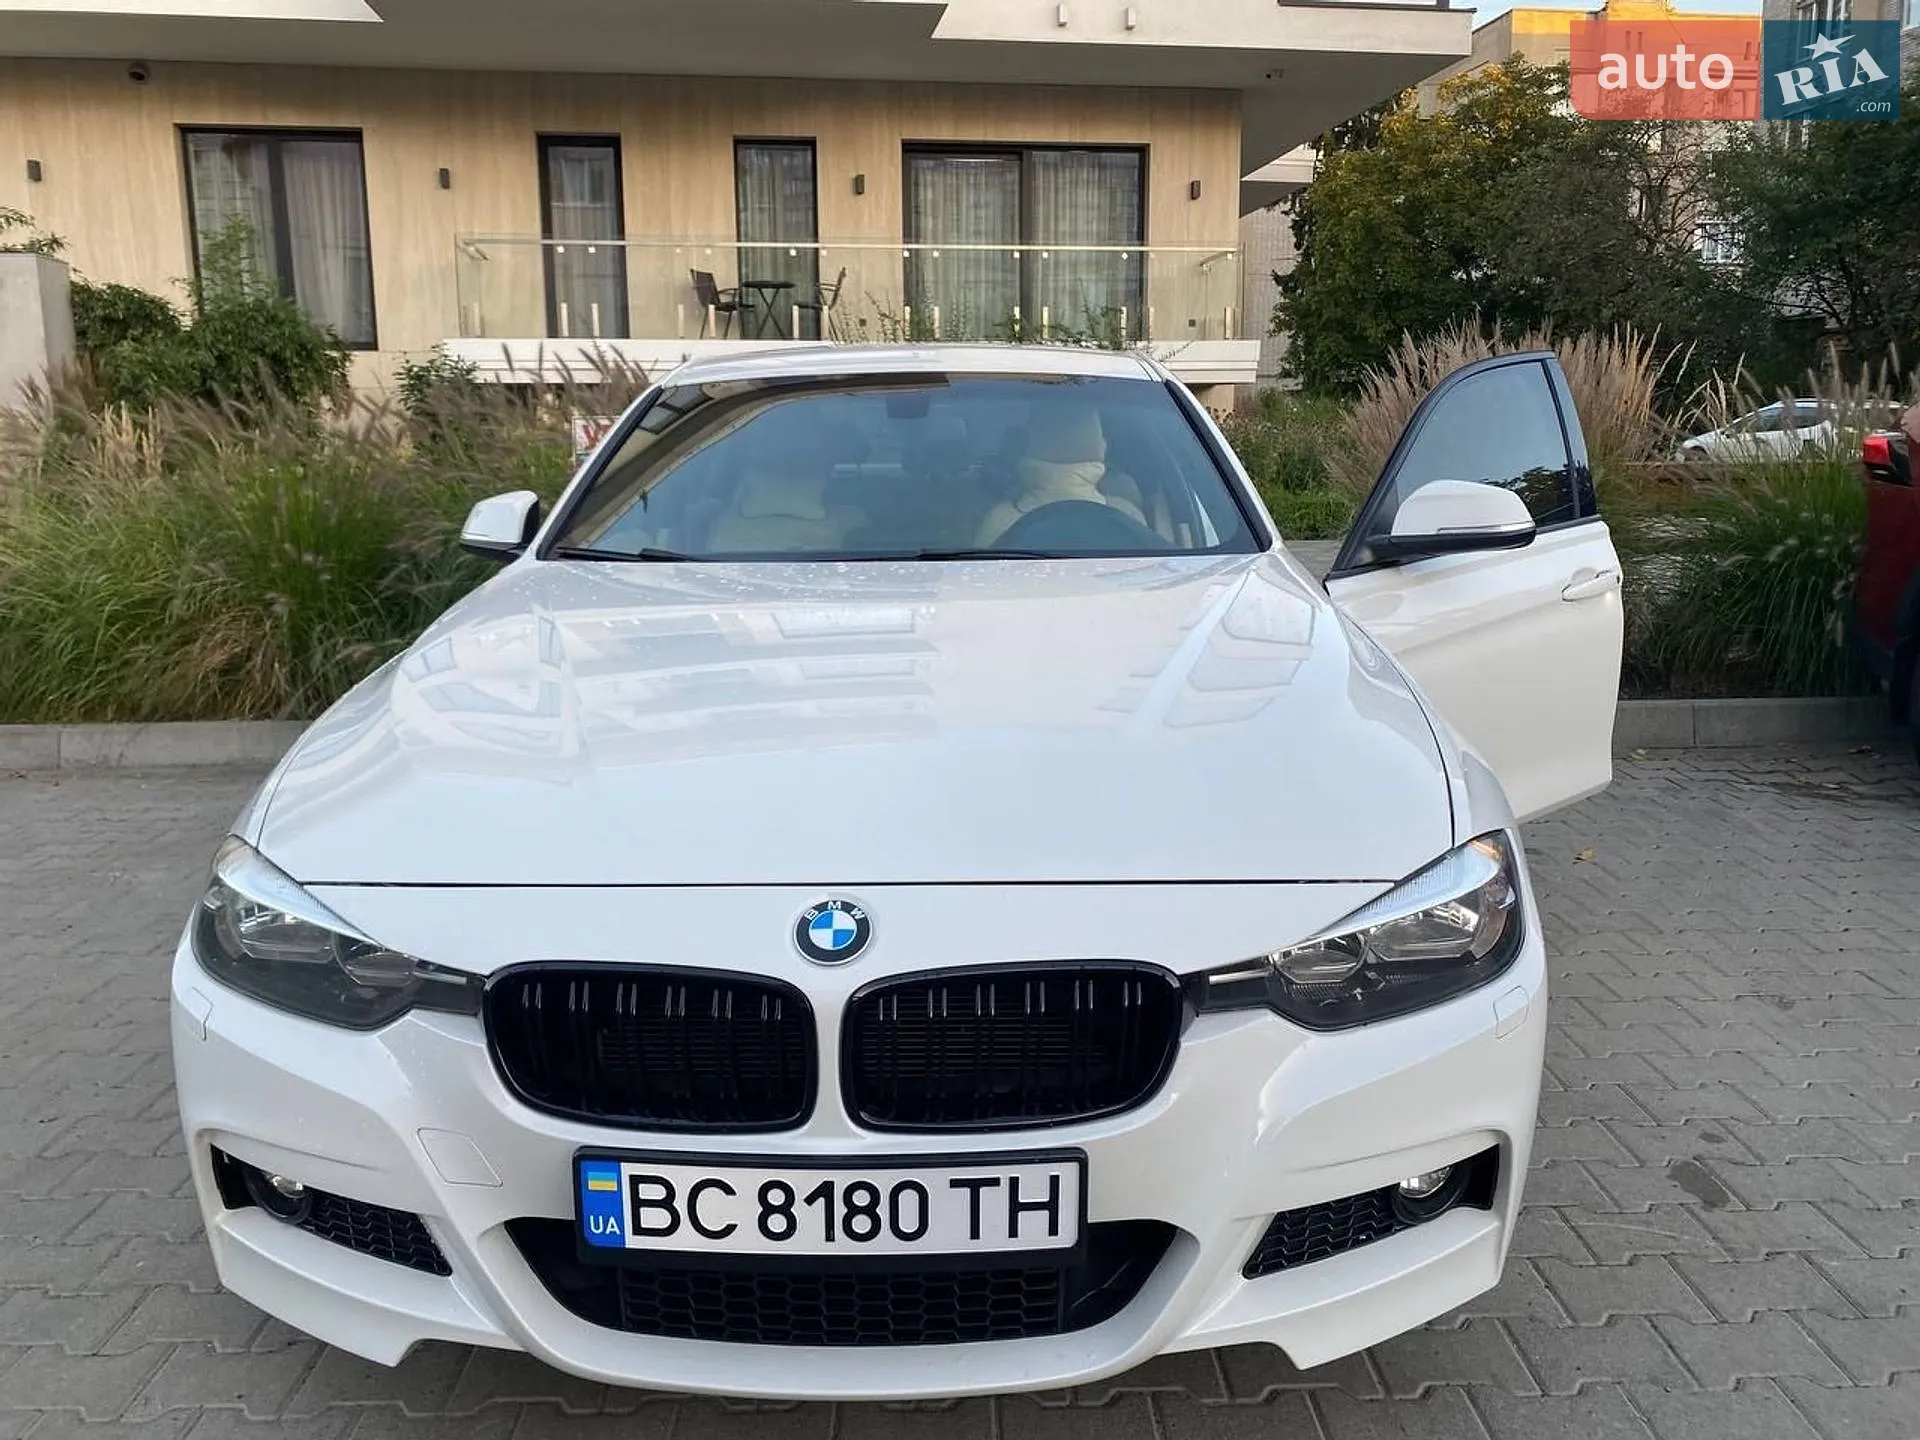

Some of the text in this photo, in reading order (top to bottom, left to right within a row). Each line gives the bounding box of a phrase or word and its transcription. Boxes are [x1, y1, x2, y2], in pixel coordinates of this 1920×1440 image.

[804, 900, 866, 920] BMW
[628, 1174, 1060, 1243] BC 8180 TH
[589, 1215, 621, 1235] UA
